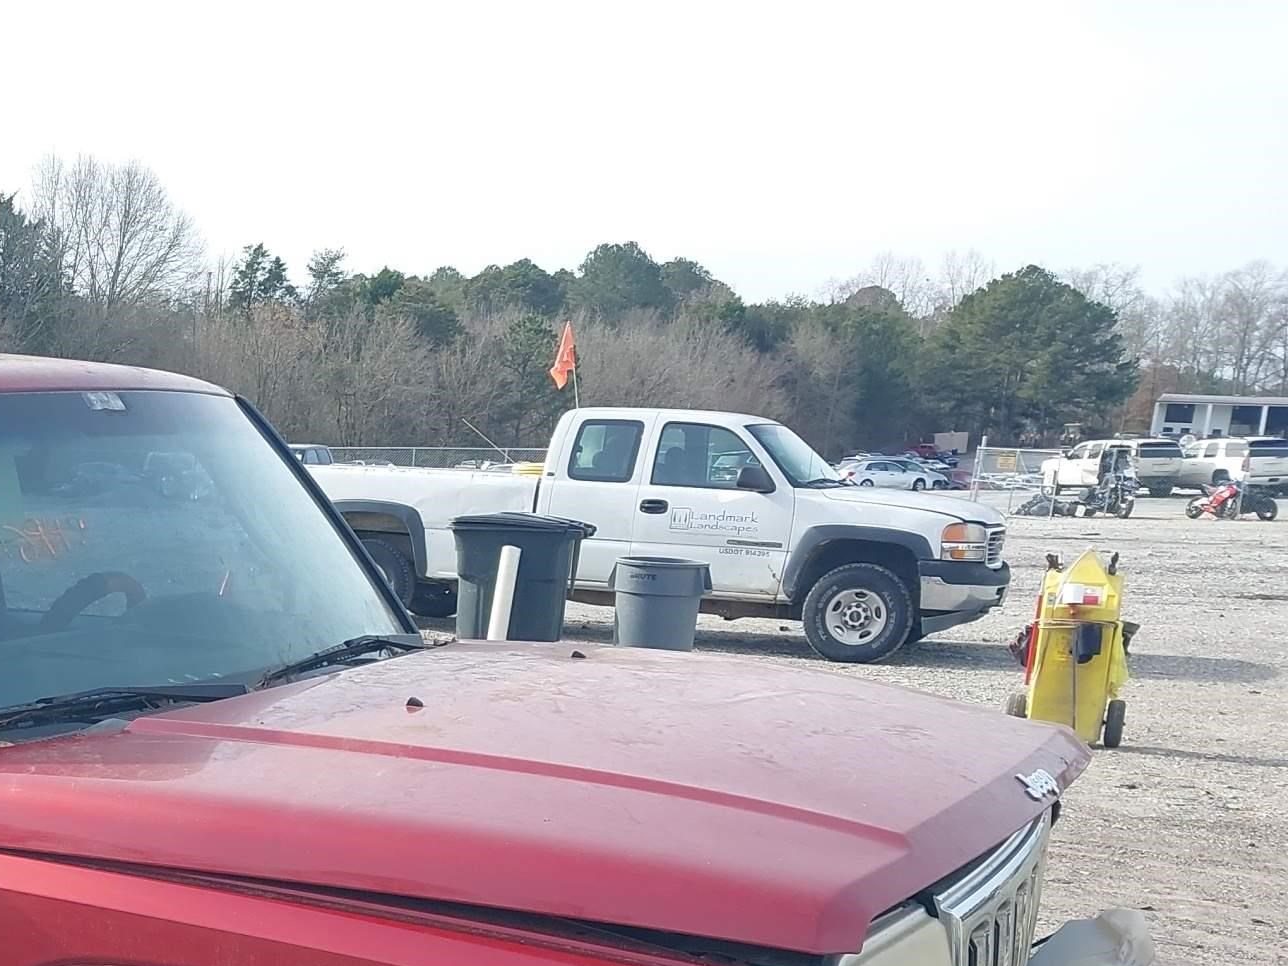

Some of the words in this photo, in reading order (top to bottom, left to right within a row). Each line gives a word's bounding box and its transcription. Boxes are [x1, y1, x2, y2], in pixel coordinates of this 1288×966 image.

[691, 510, 759, 524] Landmark
[690, 521, 759, 535] Landscapes
[718, 547, 744, 556] USDOT
